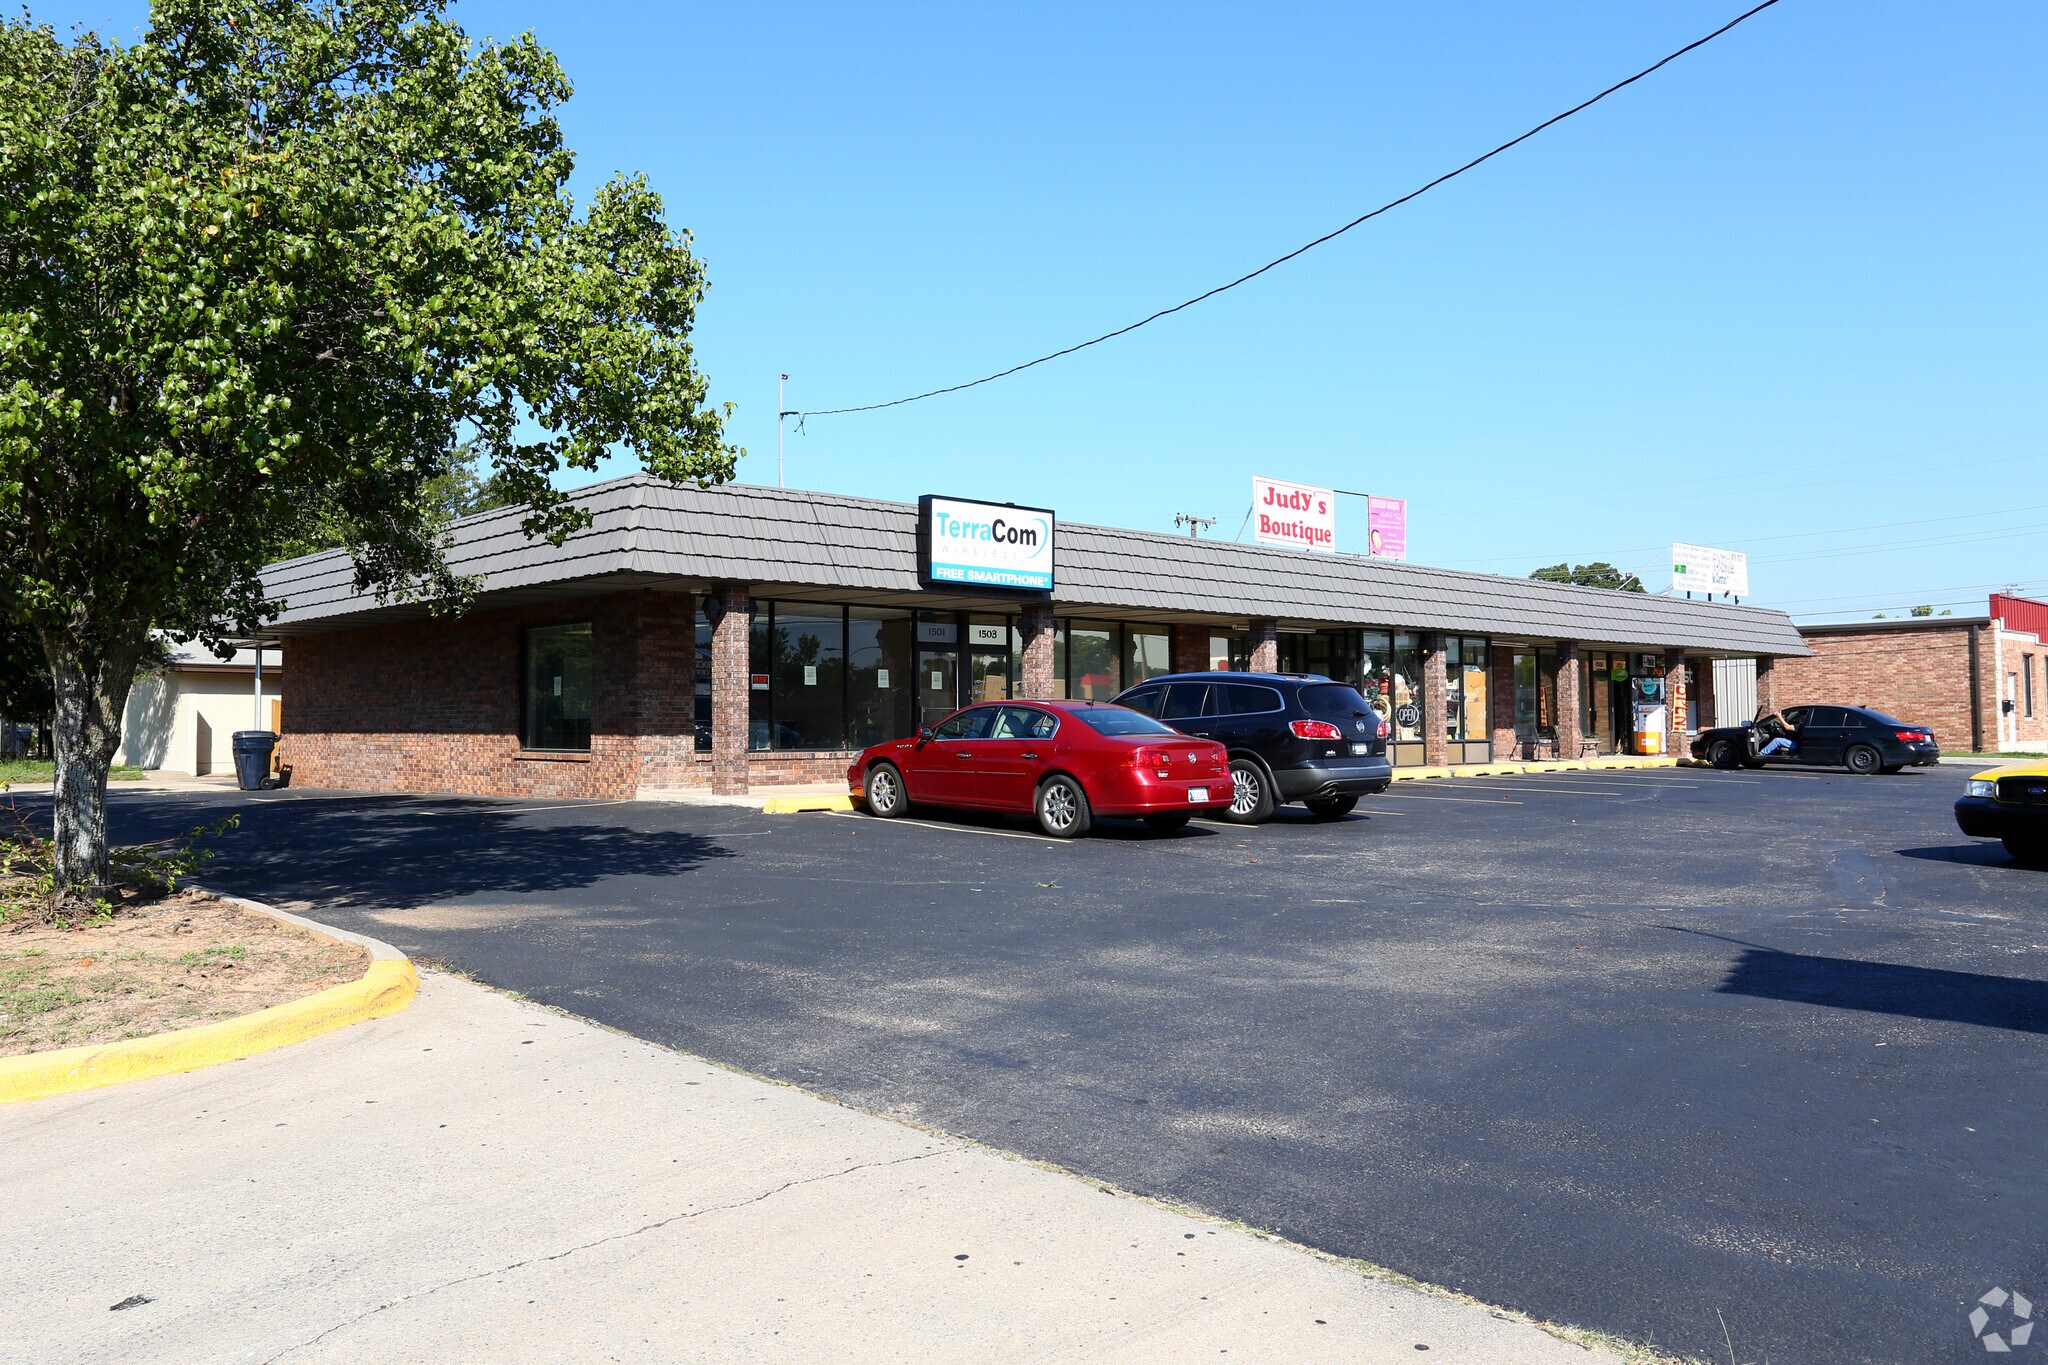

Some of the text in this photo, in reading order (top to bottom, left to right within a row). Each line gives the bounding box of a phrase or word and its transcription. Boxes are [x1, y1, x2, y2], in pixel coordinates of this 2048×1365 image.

[936, 512, 1037, 547] TerraCom
[1259, 514, 1332, 546] Boutique
[936, 567, 965, 581] FREE
[928, 627, 945, 637] 1501
[978, 630, 997, 639] 1503
[1399, 708, 1416, 722] OPEN
